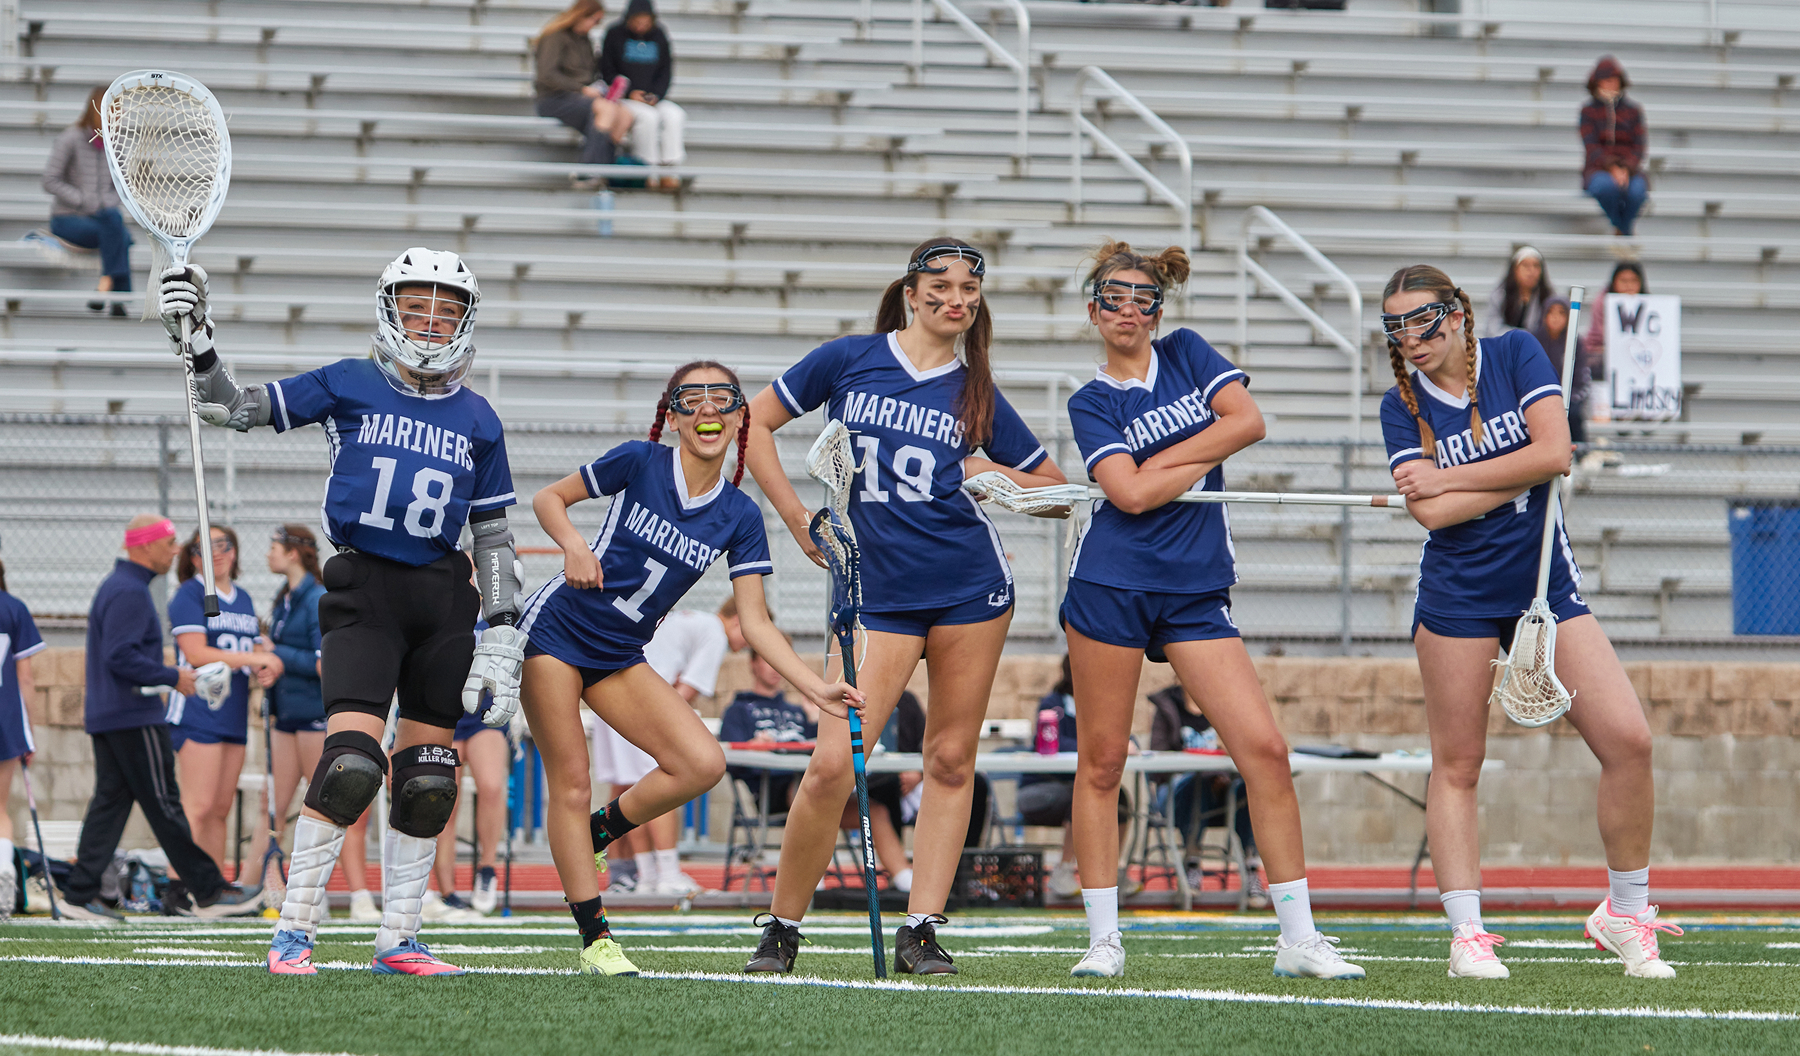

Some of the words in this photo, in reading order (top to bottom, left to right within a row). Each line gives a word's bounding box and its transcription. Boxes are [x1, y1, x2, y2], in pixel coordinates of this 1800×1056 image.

[183, 341, 196, 376] STX
[357, 413, 474, 472] MARINERS
[845, 391, 966, 449] MARINERS
[856, 435, 937, 503] 19
[358, 456, 455, 539] 18
[490, 551, 501, 605] MAVERIK
[611, 556, 669, 624] 1
[418, 755, 440, 763] KILLER
[421, 746, 454, 758] 187
[862, 815, 875, 869] harrow
